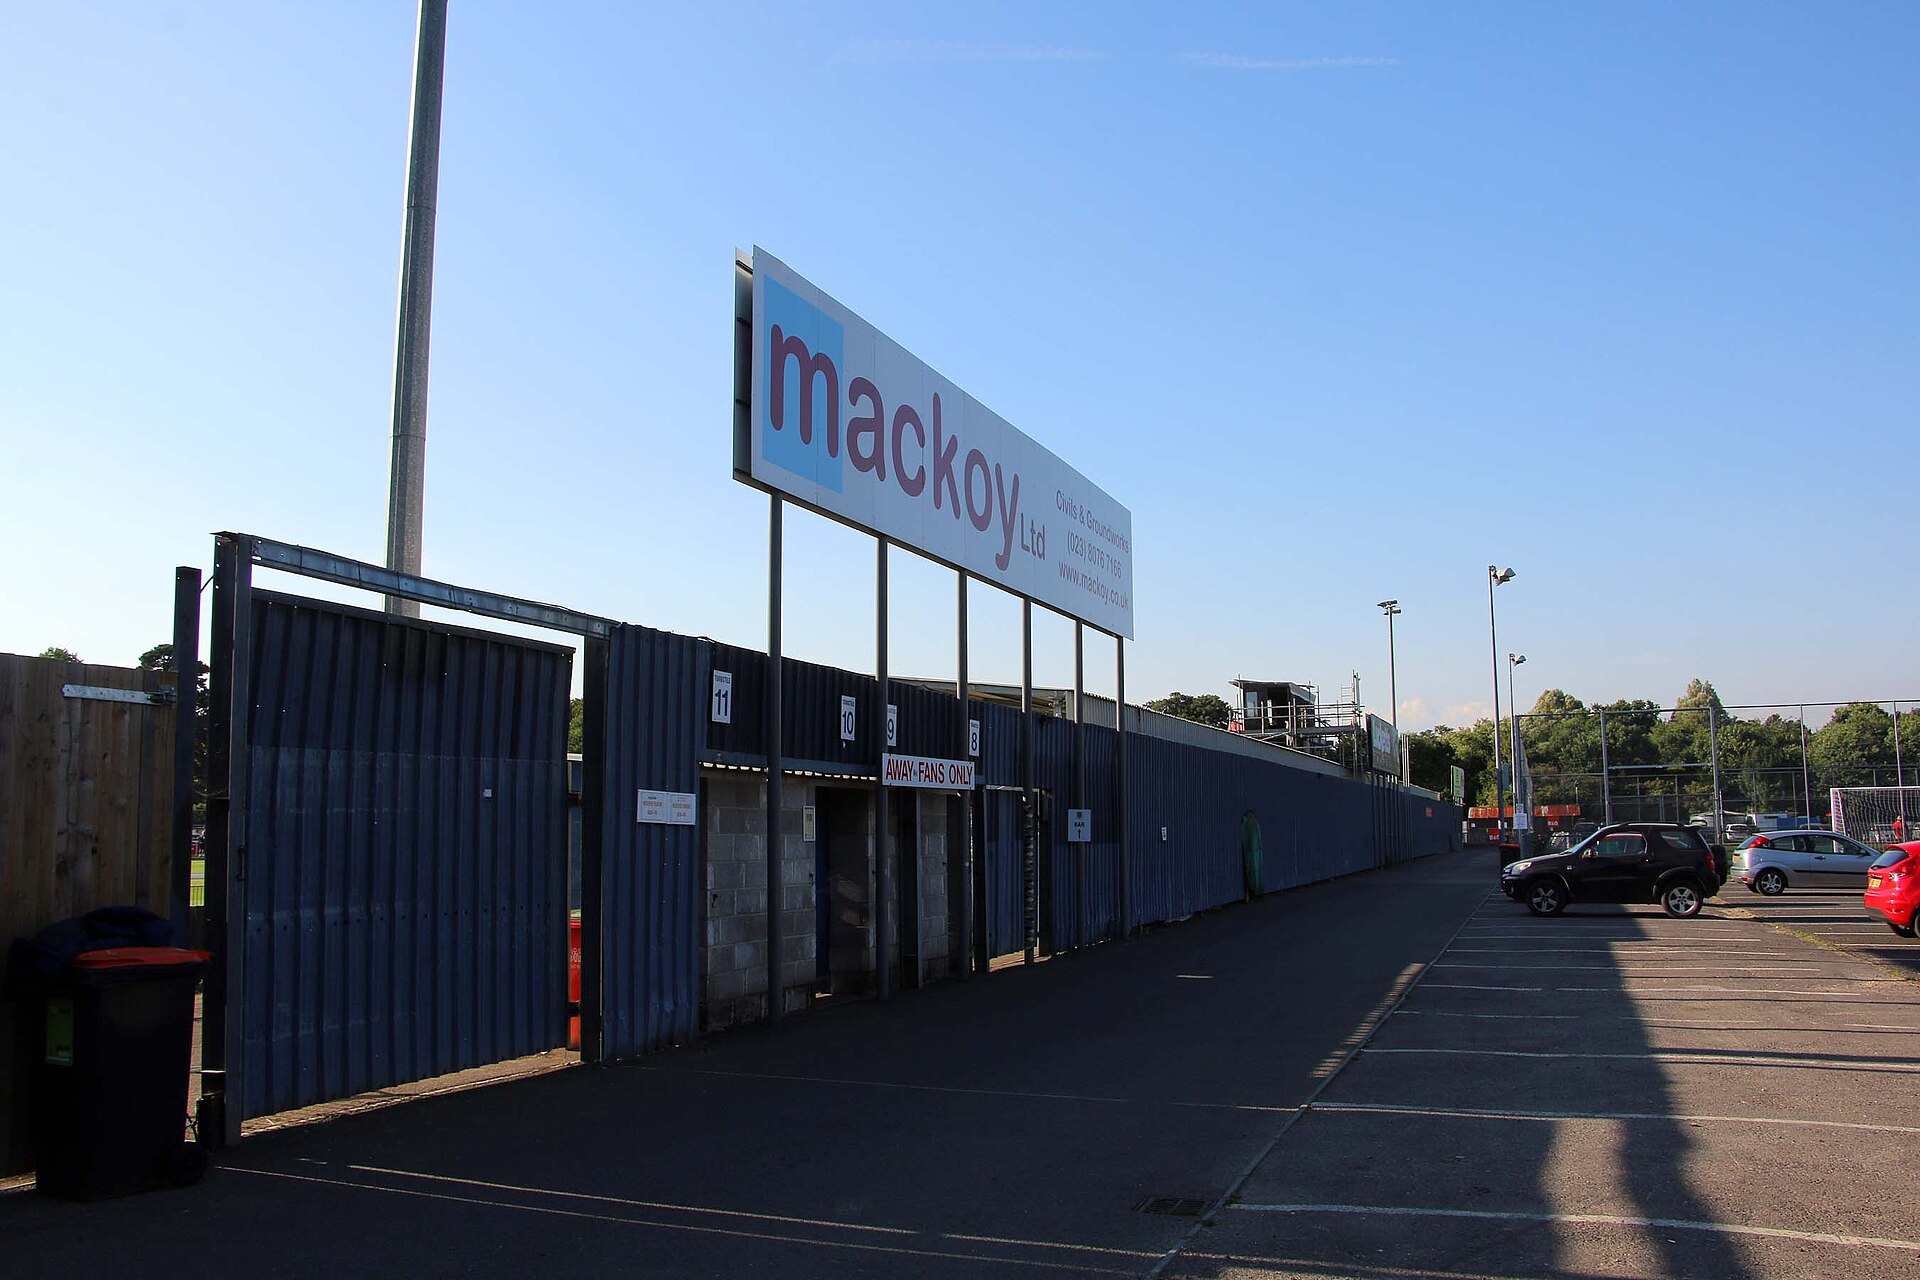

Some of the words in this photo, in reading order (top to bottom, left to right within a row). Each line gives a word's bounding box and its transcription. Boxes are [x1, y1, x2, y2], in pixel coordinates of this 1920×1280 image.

[770, 323, 1019, 572] mackoy
[1020, 512, 1046, 561] Ltd
[1056, 490, 1077, 520] Civils
[1079, 505, 1085, 526] &
[1087, 510, 1129, 554] Groundworks
[1067, 530, 1086, 562] (023)
[1088, 543, 1105, 569] 8076
[1059, 561, 1129, 611] www.mackoy.co.uk
[715, 689, 728, 716] 11
[843, 711, 853, 735] 10
[887, 718, 894, 741] 9
[971, 732, 977, 751] 8
[885, 759, 914, 782] AWAY
[918, 761, 945, 784] FANS
[948, 763, 973, 786] ONLY
